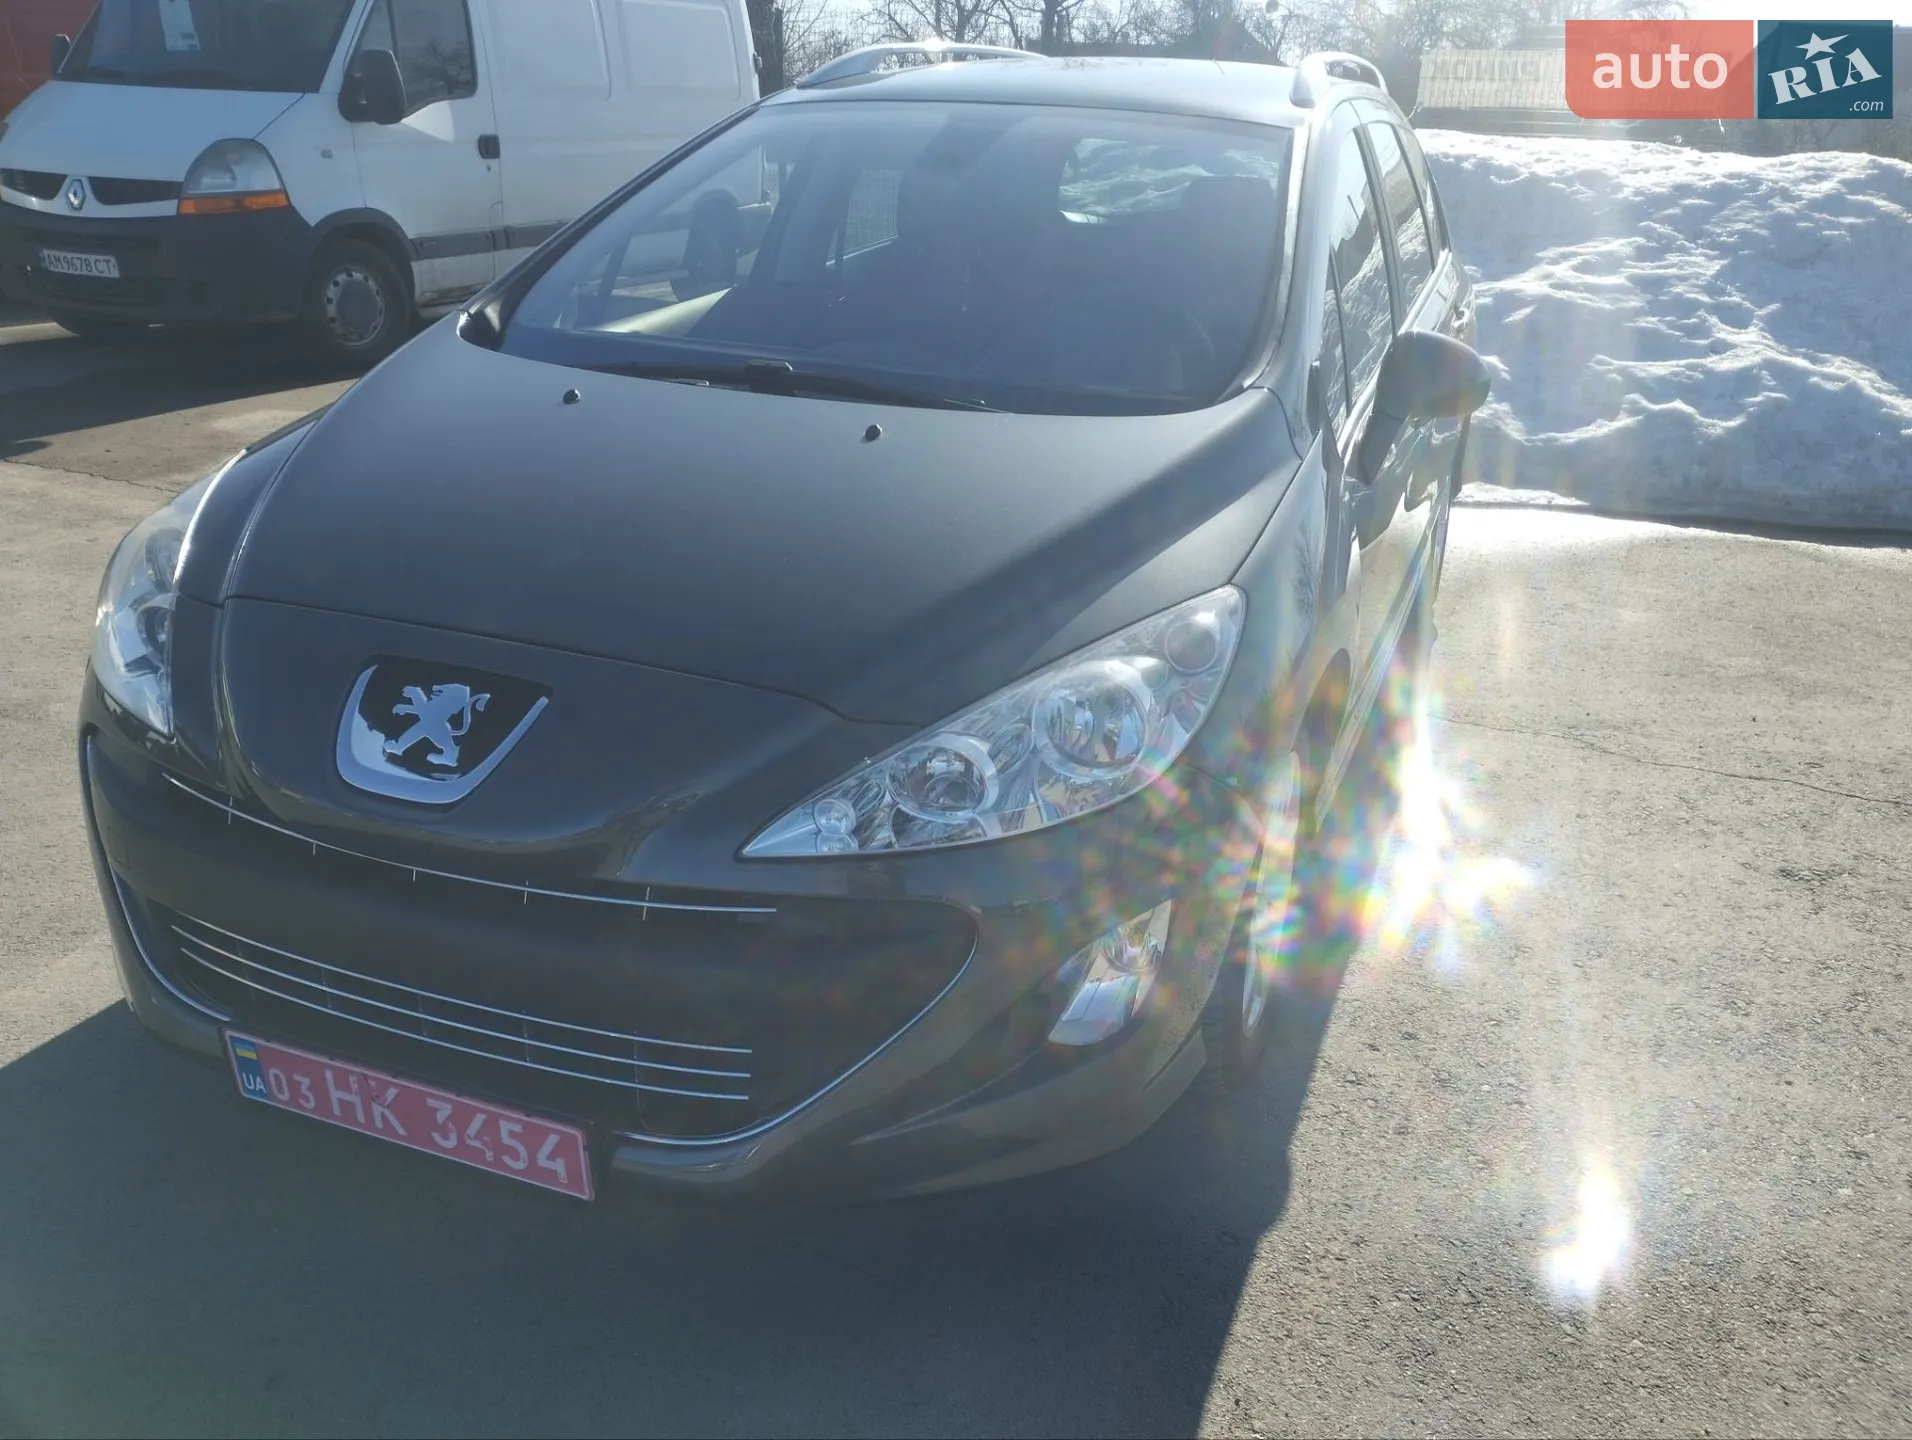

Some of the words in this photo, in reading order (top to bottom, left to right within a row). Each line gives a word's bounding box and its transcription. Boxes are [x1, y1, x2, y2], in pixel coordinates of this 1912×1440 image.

[242, 1072, 268, 1094] UA
[268, 1068, 316, 1111] 03
[325, 1069, 408, 1137] HK
[426, 1098, 569, 1184] 3454
